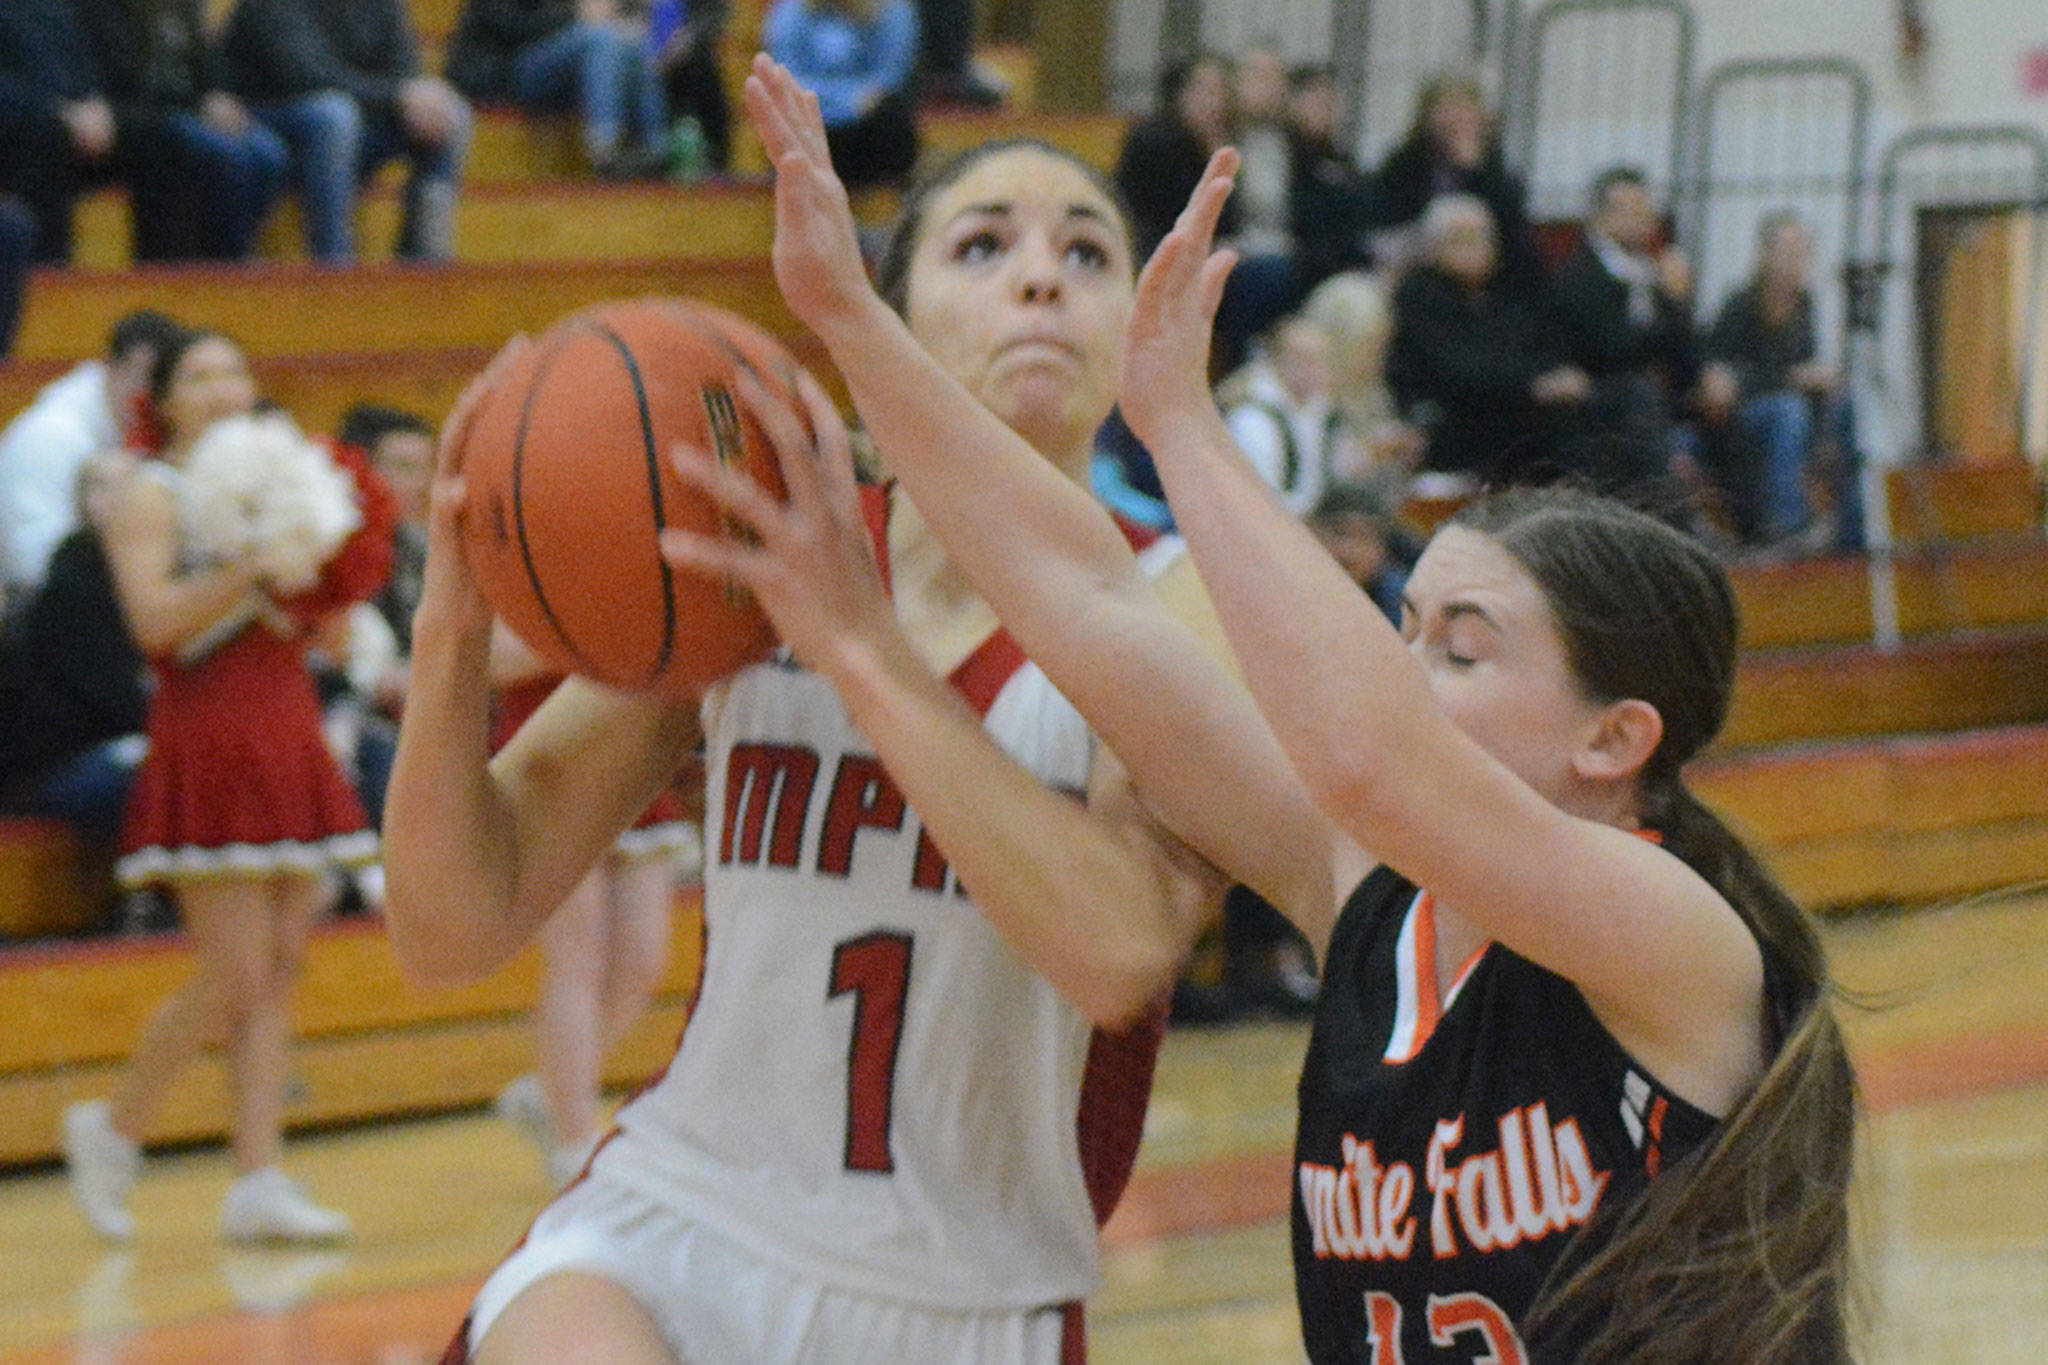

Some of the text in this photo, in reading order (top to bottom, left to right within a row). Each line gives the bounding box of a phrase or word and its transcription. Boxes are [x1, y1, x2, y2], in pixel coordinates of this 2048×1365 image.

[719, 742, 968, 896] MP
[829, 928, 914, 1174] 1
[1299, 1099, 1613, 1261] nite Falls
